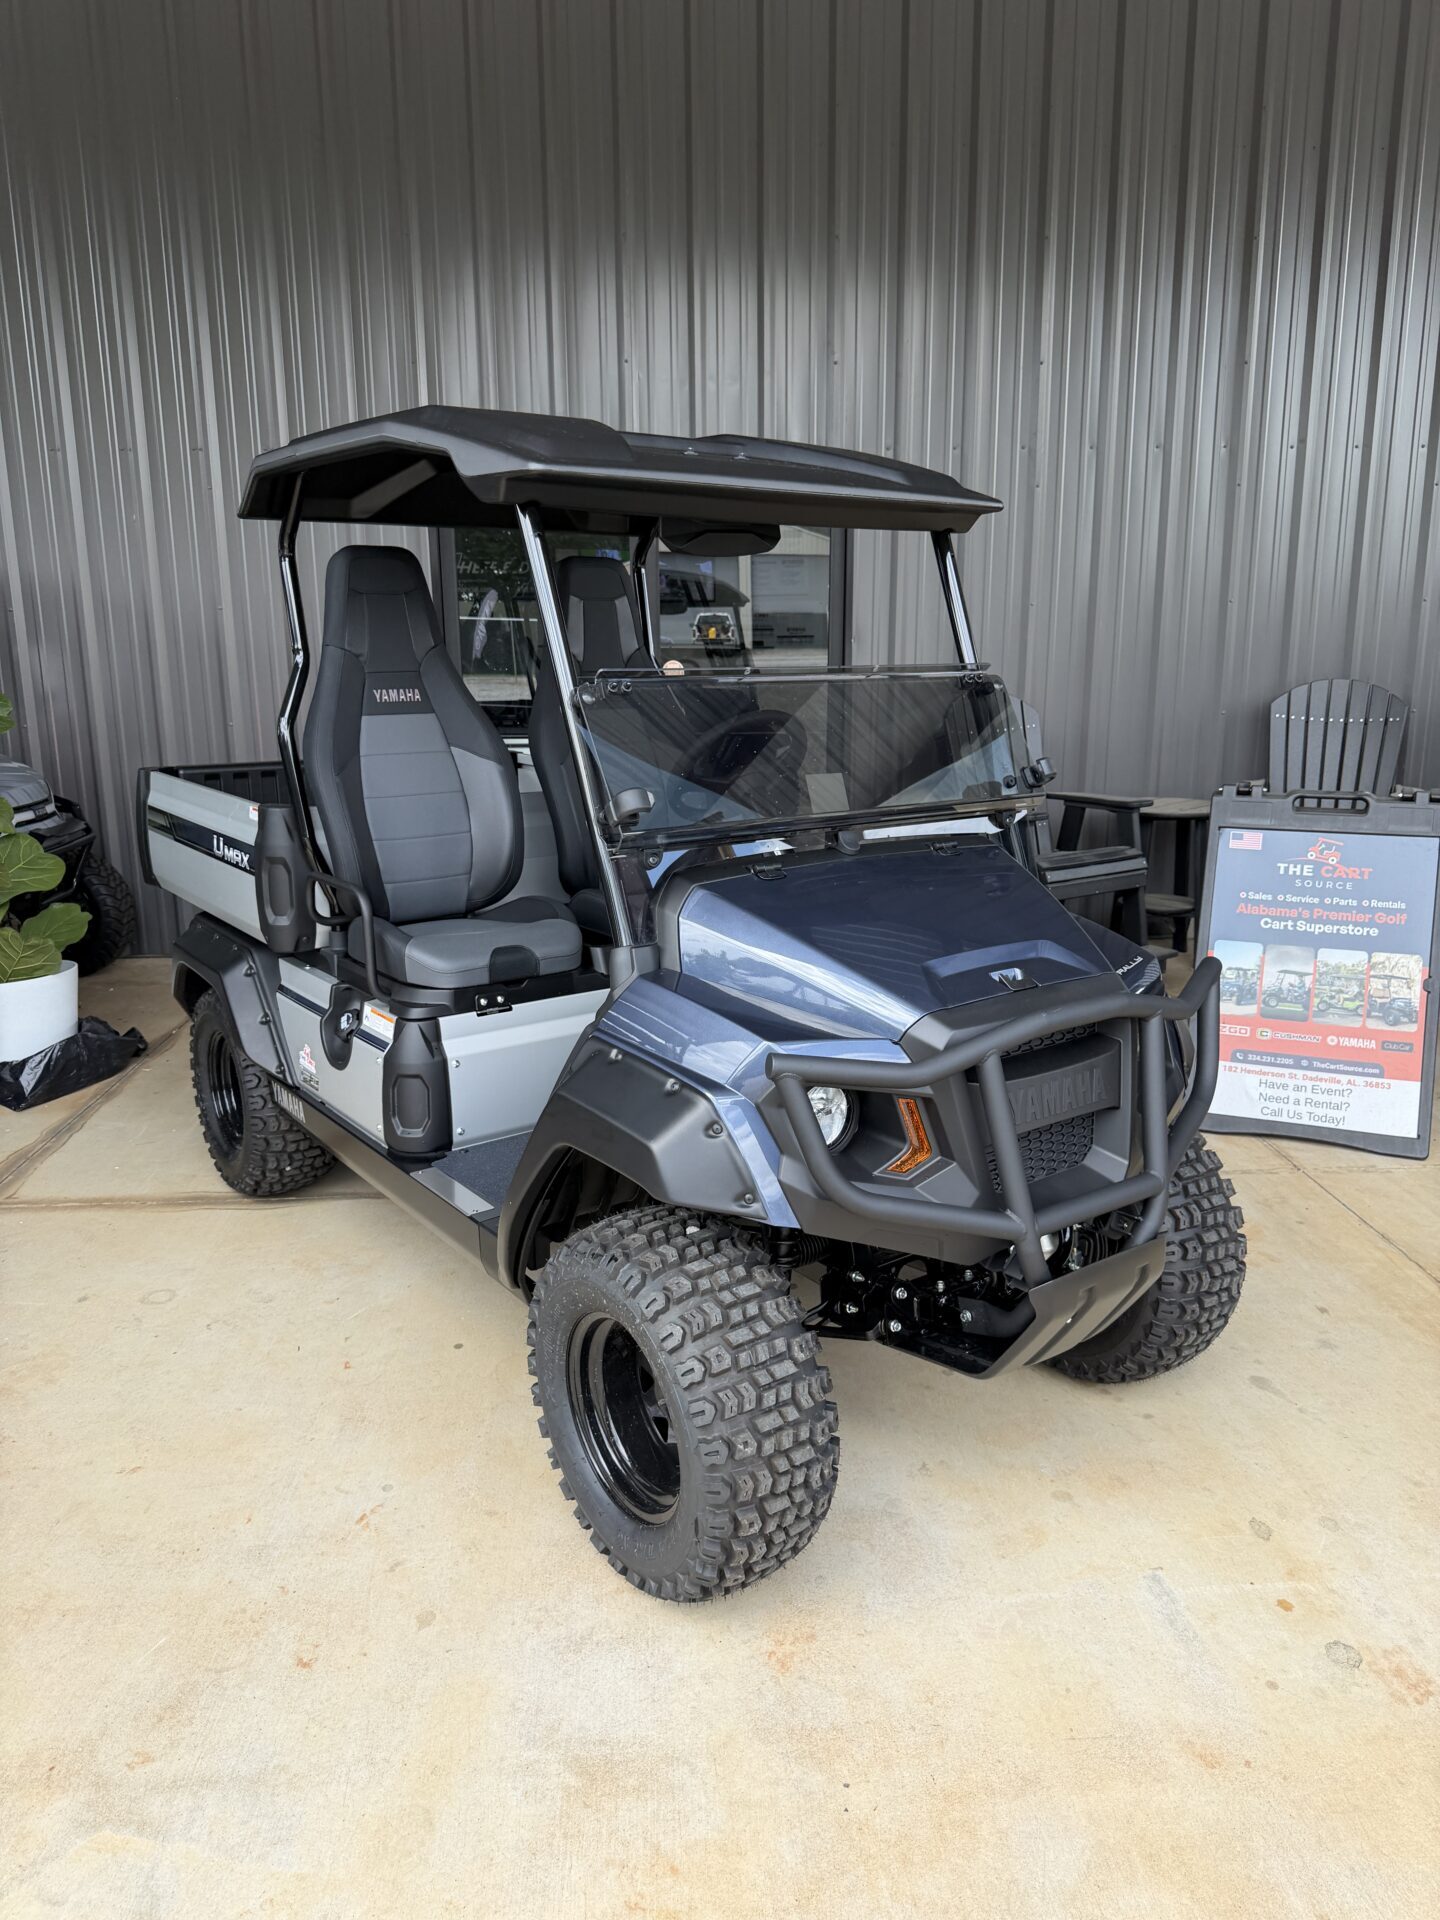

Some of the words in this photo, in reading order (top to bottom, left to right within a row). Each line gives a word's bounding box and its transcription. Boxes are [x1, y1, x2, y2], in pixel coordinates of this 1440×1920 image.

[373, 688, 421, 703] YAMAHA
[1277, 863, 1314, 877] THE
[1320, 865, 1373, 880] CART
[1295, 879, 1353, 890] SOURCE
[1248, 891, 1273, 901] Sales
[1285, 894, 1320, 904] Service
[1333, 897, 1357, 907] Parts
[1371, 899, 1406, 909] Rentals
[1236, 903, 1310, 919] Alabama's
[1313, 908, 1372, 922] Premier
[1374, 913, 1407, 925] Golf
[1260, 917, 1294, 931] Cart
[1296, 920, 1379, 936] Superstore
[1115, 955, 1143, 975] RALLY
[1273, 1032, 1320, 1042] CUSHMAN
[1338, 1036, 1376, 1049] YAMAHA
[1312, 1061, 1380, 1074] TheCartSource.com
[1222, 1064, 1239, 1073] 182
[1240, 1067, 1286, 1078] Henderson
[1288, 1072, 1299, 1080] St.
[1302, 1074, 1344, 1086] Dadeville,
[1362, 1080, 1391, 1090] 36853
[1008, 1068, 1106, 1122] YAMAHA
[1258, 1078, 1289, 1092] Have
[1293, 1083, 1308, 1093] an
[1311, 1084, 1353, 1098] Event?
[271, 1080, 306, 1124] YAMAHA
[1258, 1093, 1289, 1105] Need
[1293, 1098, 1301, 1106] a
[1304, 1097, 1350, 1111] Rental?
[1260, 1106, 1283, 1118] Call
[1286, 1109, 1302, 1120] Us
[1306, 1111, 1346, 1126] Today!
